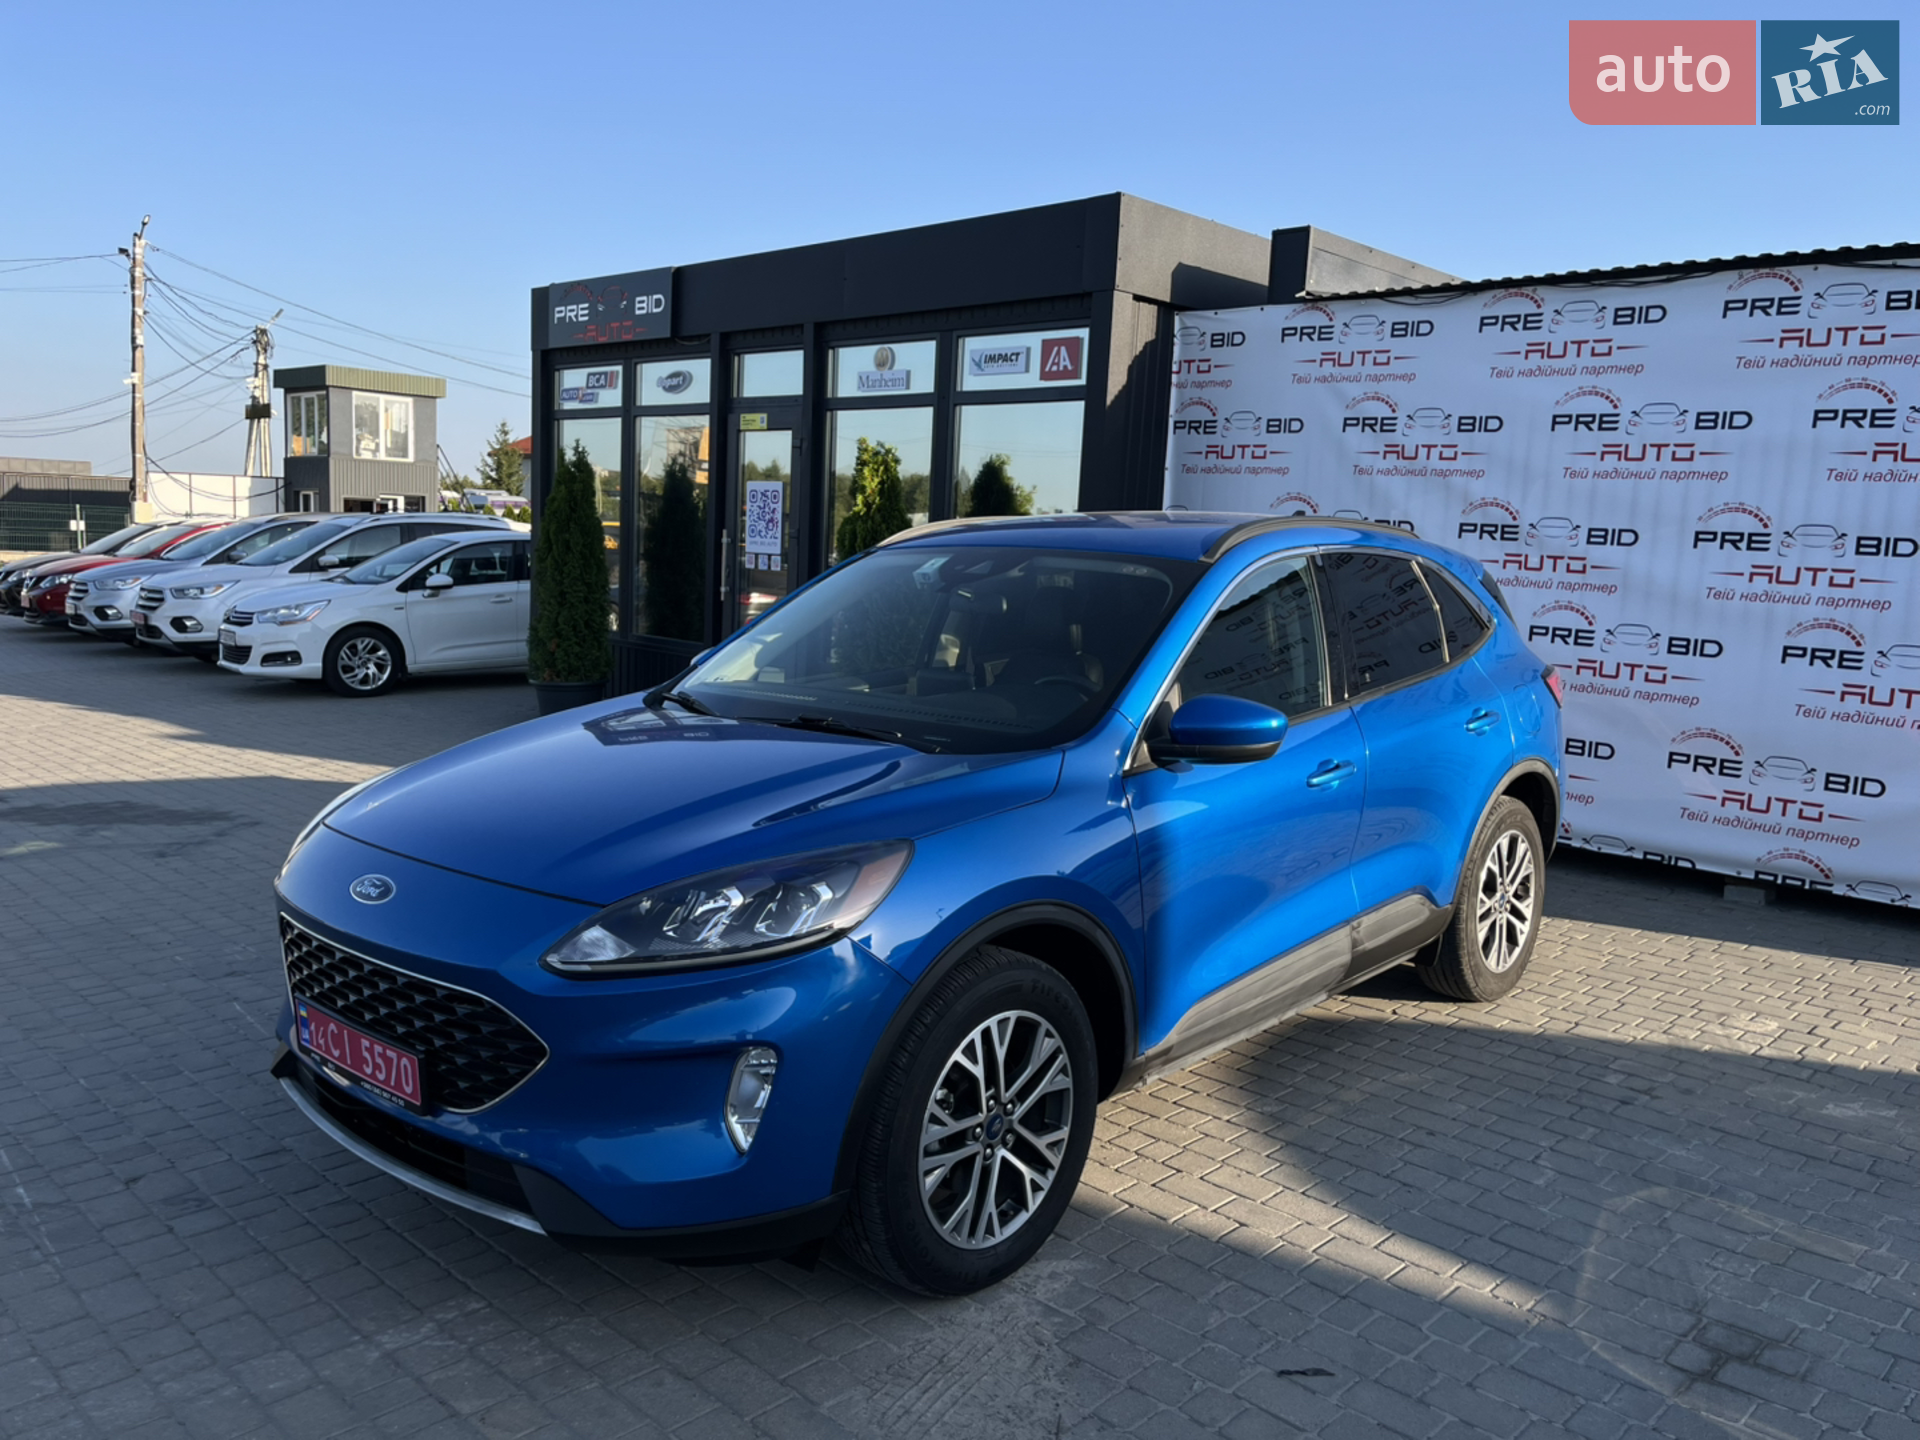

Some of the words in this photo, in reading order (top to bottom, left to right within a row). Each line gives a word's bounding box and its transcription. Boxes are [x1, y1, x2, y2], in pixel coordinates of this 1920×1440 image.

[554, 303, 590, 325] PRE
[635, 294, 665, 315] BID
[1722, 295, 1803, 319] PRE
[1478, 312, 1544, 333] PRE
[1612, 304, 1667, 326] BID
[585, 320, 633, 342] AUTO
[1210, 331, 1246, 348] BID
[1281, 325, 1335, 343] PRE
[1390, 320, 1435, 338] BID
[1779, 325, 1887, 349] AUTO
[983, 352, 1021, 364] IMPACT
[1319, 349, 1392, 368] AUTO
[1524, 338, 1613, 360] AUTO
[1489, 366, 1515, 379] Твій
[1516, 364, 1577, 378] надійний
[1580, 363, 1645, 378] партнер
[1735, 356, 1766, 369] Твій
[1769, 353, 1842, 369] надійний
[588, 374, 606, 387] BCA
[858, 373, 905, 389] Manheim
[1313, 372, 1362, 384] надійний
[1364, 372, 1416, 384] партнер
[1173, 420, 1218, 435] PRE
[1266, 417, 1304, 434] BID
[1342, 416, 1398, 433] PRE
[1456, 415, 1504, 433] BID
[1550, 413, 1621, 432] PRE
[1694, 411, 1753, 430] BID
[1811, 408, 1897, 429] PRE
[1205, 444, 1267, 460] AUTO
[1383, 444, 1458, 461] AUTO
[1600, 443, 1696, 462] AUTO
[1352, 465, 1373, 476] Твій
[1376, 465, 1427, 478] надійний
[1430, 468, 1486, 480] партнер
[1562, 467, 1589, 480] Твій
[1592, 467, 1657, 481] надійний
[1659, 469, 1729, 484] партнер
[1826, 468, 1859, 482] Твій
[1458, 522, 1520, 542] PRE
[1586, 527, 1639, 547] BID
[1692, 530, 1772, 552] PRE
[1854, 535, 1919, 558] BID
[1502, 553, 1587, 575] AUTO
[1748, 564, 1856, 589] AUTO
[1556, 580, 1618, 596] партнер
[1705, 586, 1736, 601] Твій
[1739, 588, 1812, 606] надійний
[1815, 596, 1892, 613] партнер
[1528, 624, 1596, 648] PRE
[1666, 635, 1724, 658] BID
[1781, 645, 1865, 671] PRE
[1575, 658, 1668, 685] AUTO
[1569, 681, 1630, 698] надійний
[1633, 689, 1700, 708] партнер
[1795, 703, 1827, 720] Твій
[1830, 710, 1907, 728] надійний
[1564, 737, 1616, 760] BID
[1666, 750, 1744, 779] PRE
[1823, 772, 1887, 799] BID
[1720, 789, 1825, 823] AUTO
[1679, 807, 1709, 823] Твій
[1712, 815, 1782, 836] надійний
[1785, 825, 1860, 849] партнер
[360, 1038, 413, 1094] 5570
